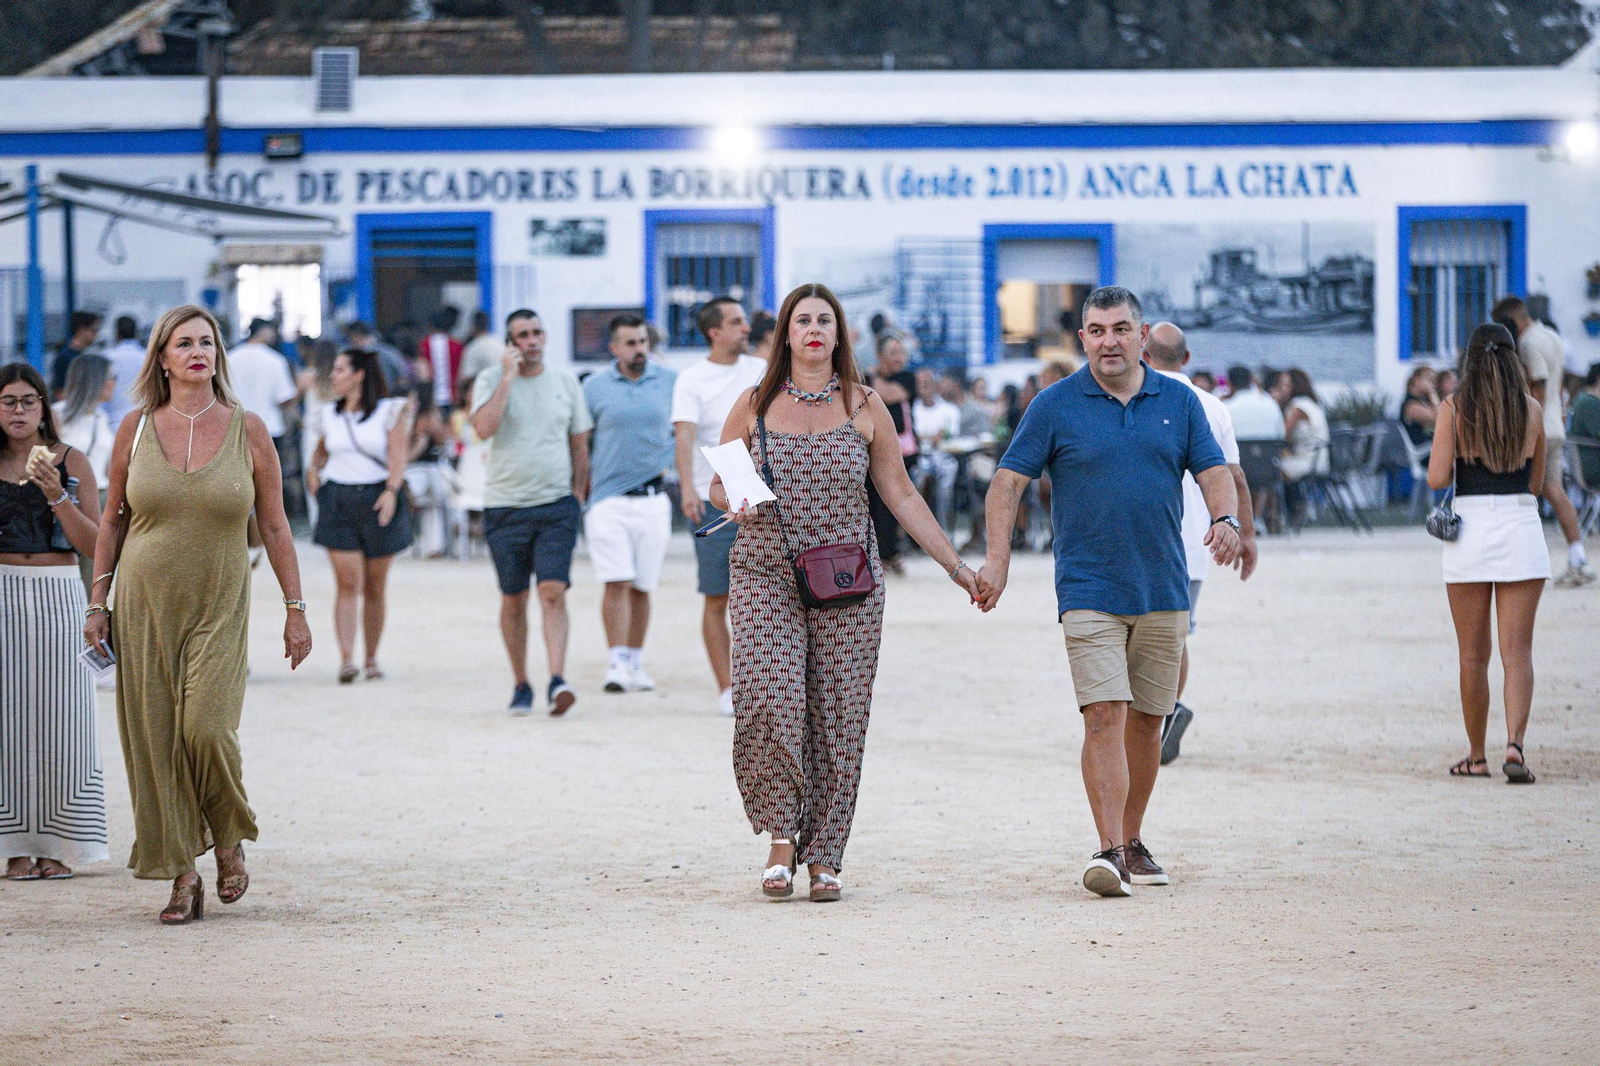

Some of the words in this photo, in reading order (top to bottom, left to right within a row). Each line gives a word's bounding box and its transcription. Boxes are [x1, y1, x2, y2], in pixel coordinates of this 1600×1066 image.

[297, 170, 342, 203] DE
[357, 168, 578, 203] PESCADORES
[592, 167, 636, 201] LA
[650, 165, 871, 204] BORRIQUERA
[1080, 164, 1174, 198] ANCA
[1187, 163, 1230, 197] LA
[1239, 163, 1358, 198] CHATA
